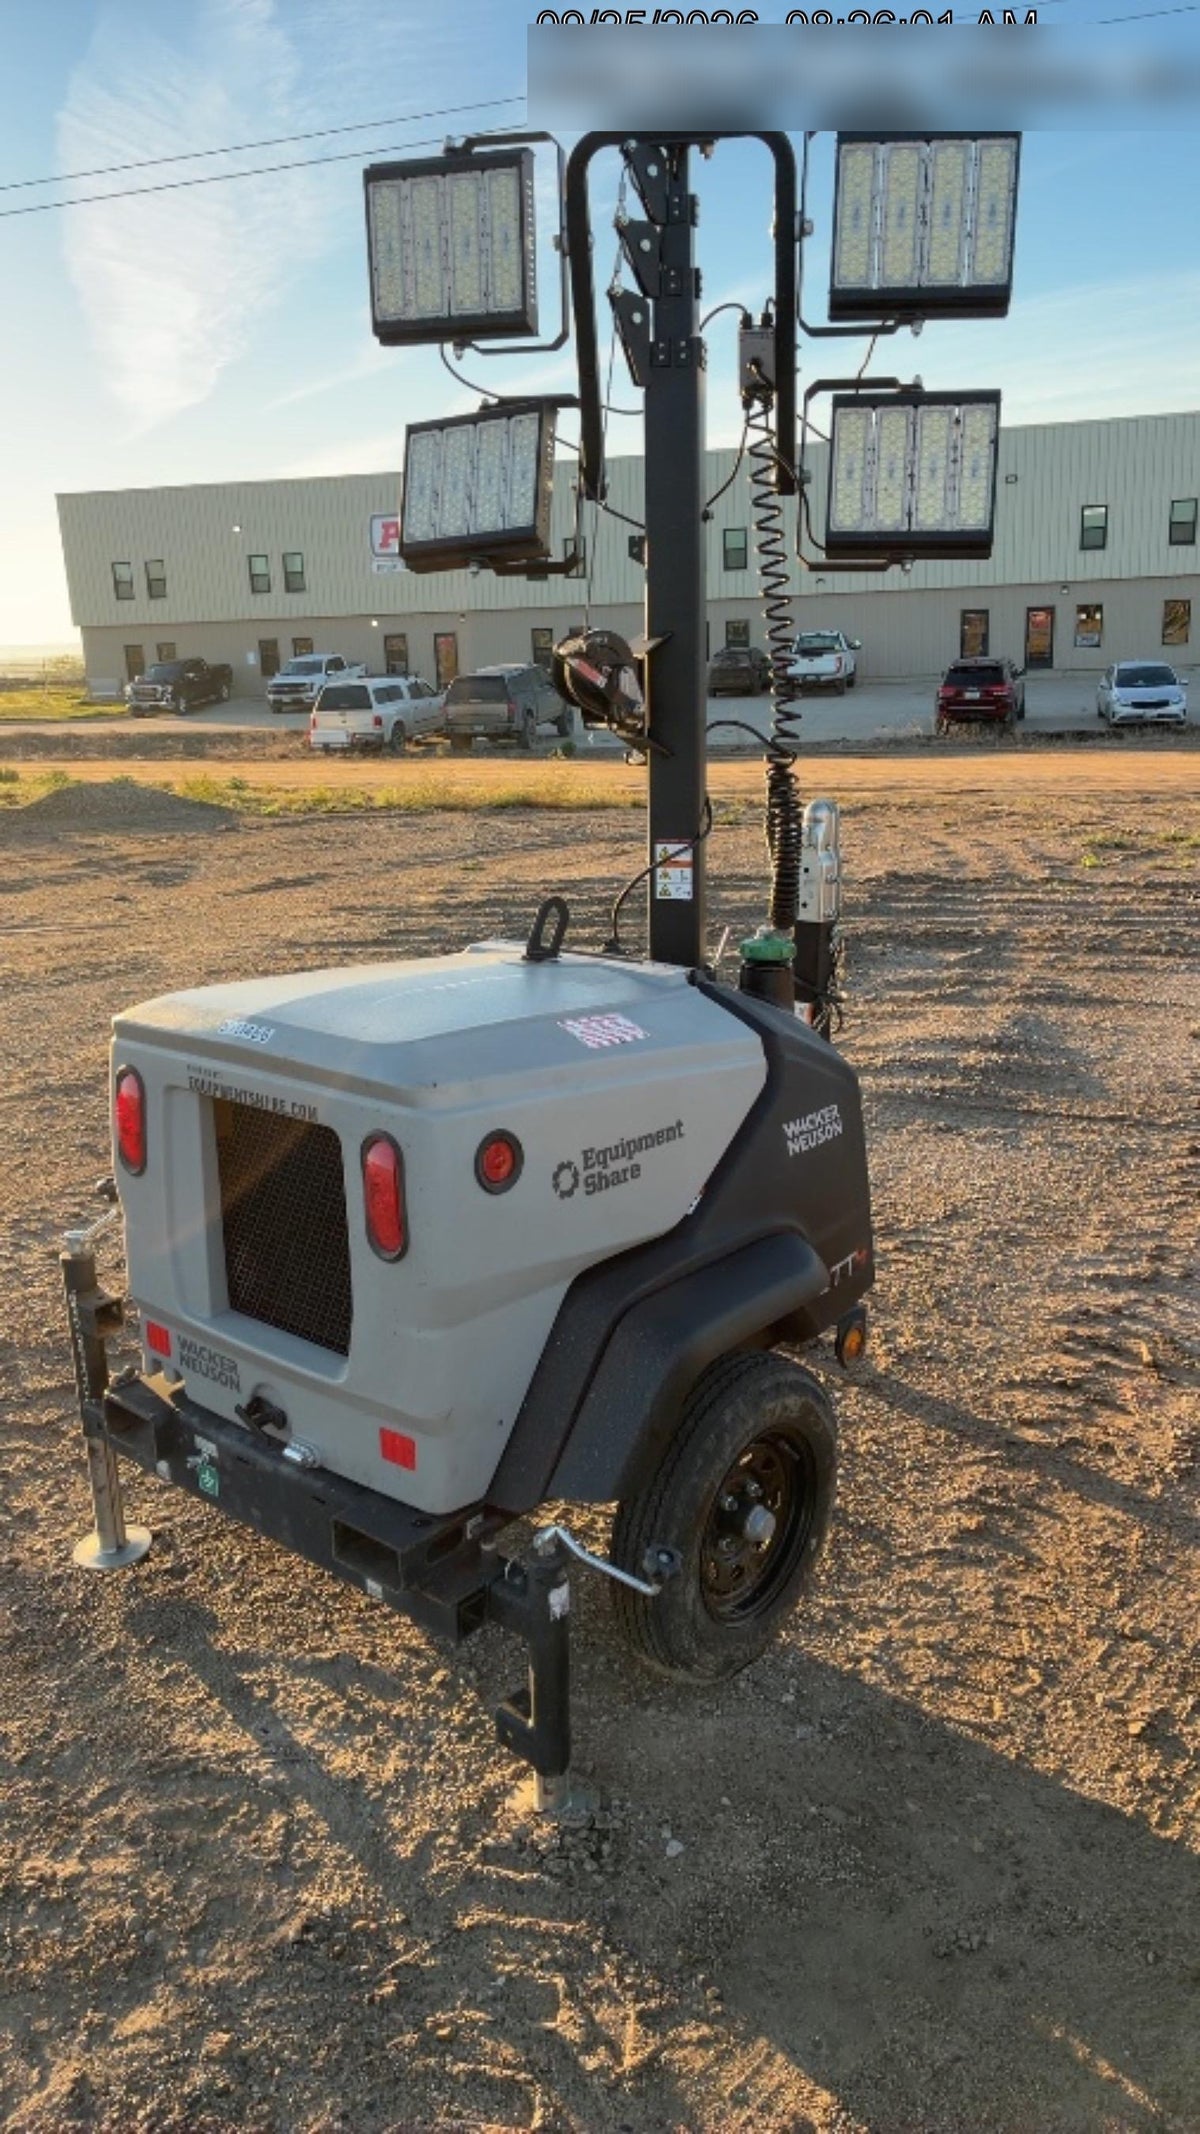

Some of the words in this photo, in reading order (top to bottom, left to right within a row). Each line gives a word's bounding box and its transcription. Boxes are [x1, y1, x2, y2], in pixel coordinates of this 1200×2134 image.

[782, 1104, 840, 1139] WACKER
[786, 1119, 842, 1156] NEUSON
[581, 1118, 686, 1171] Equipment
[583, 1163, 641, 1196] Share
[177, 1334, 238, 1376] WACKER
[179, 1351, 241, 1393] NEUSON
